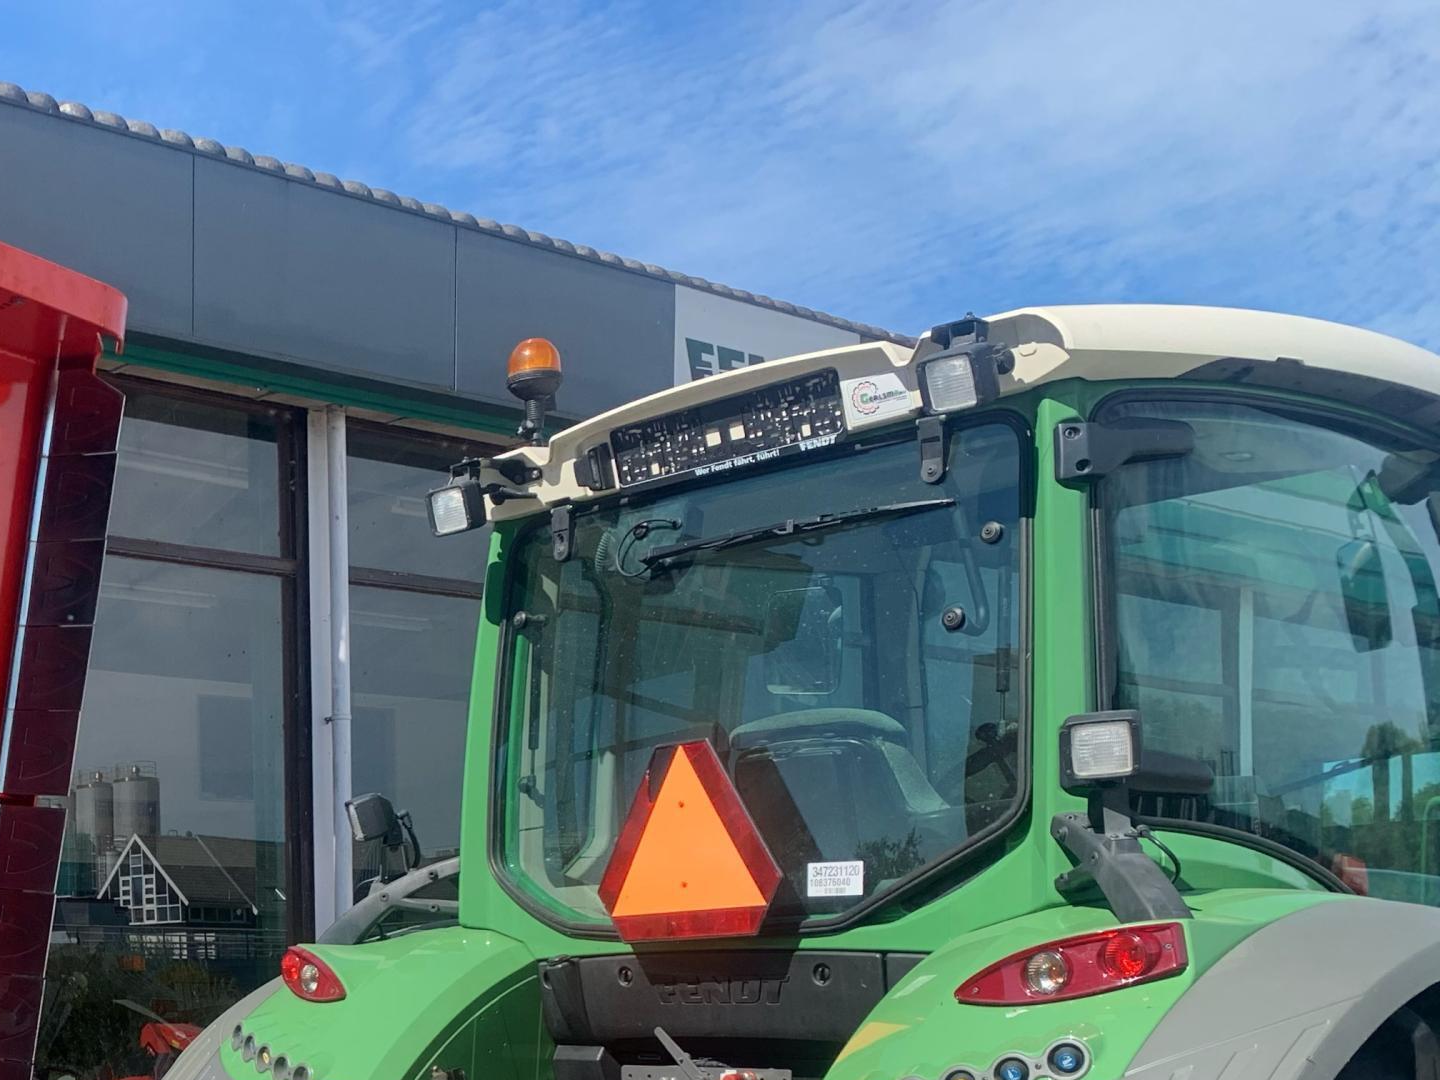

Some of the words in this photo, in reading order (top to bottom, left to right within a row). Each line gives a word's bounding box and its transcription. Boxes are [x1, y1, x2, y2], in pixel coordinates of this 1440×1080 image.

[799, 434, 838, 451] FENDT
[711, 462, 733, 472] Fendt
[655, 976, 790, 1005] FENDT
